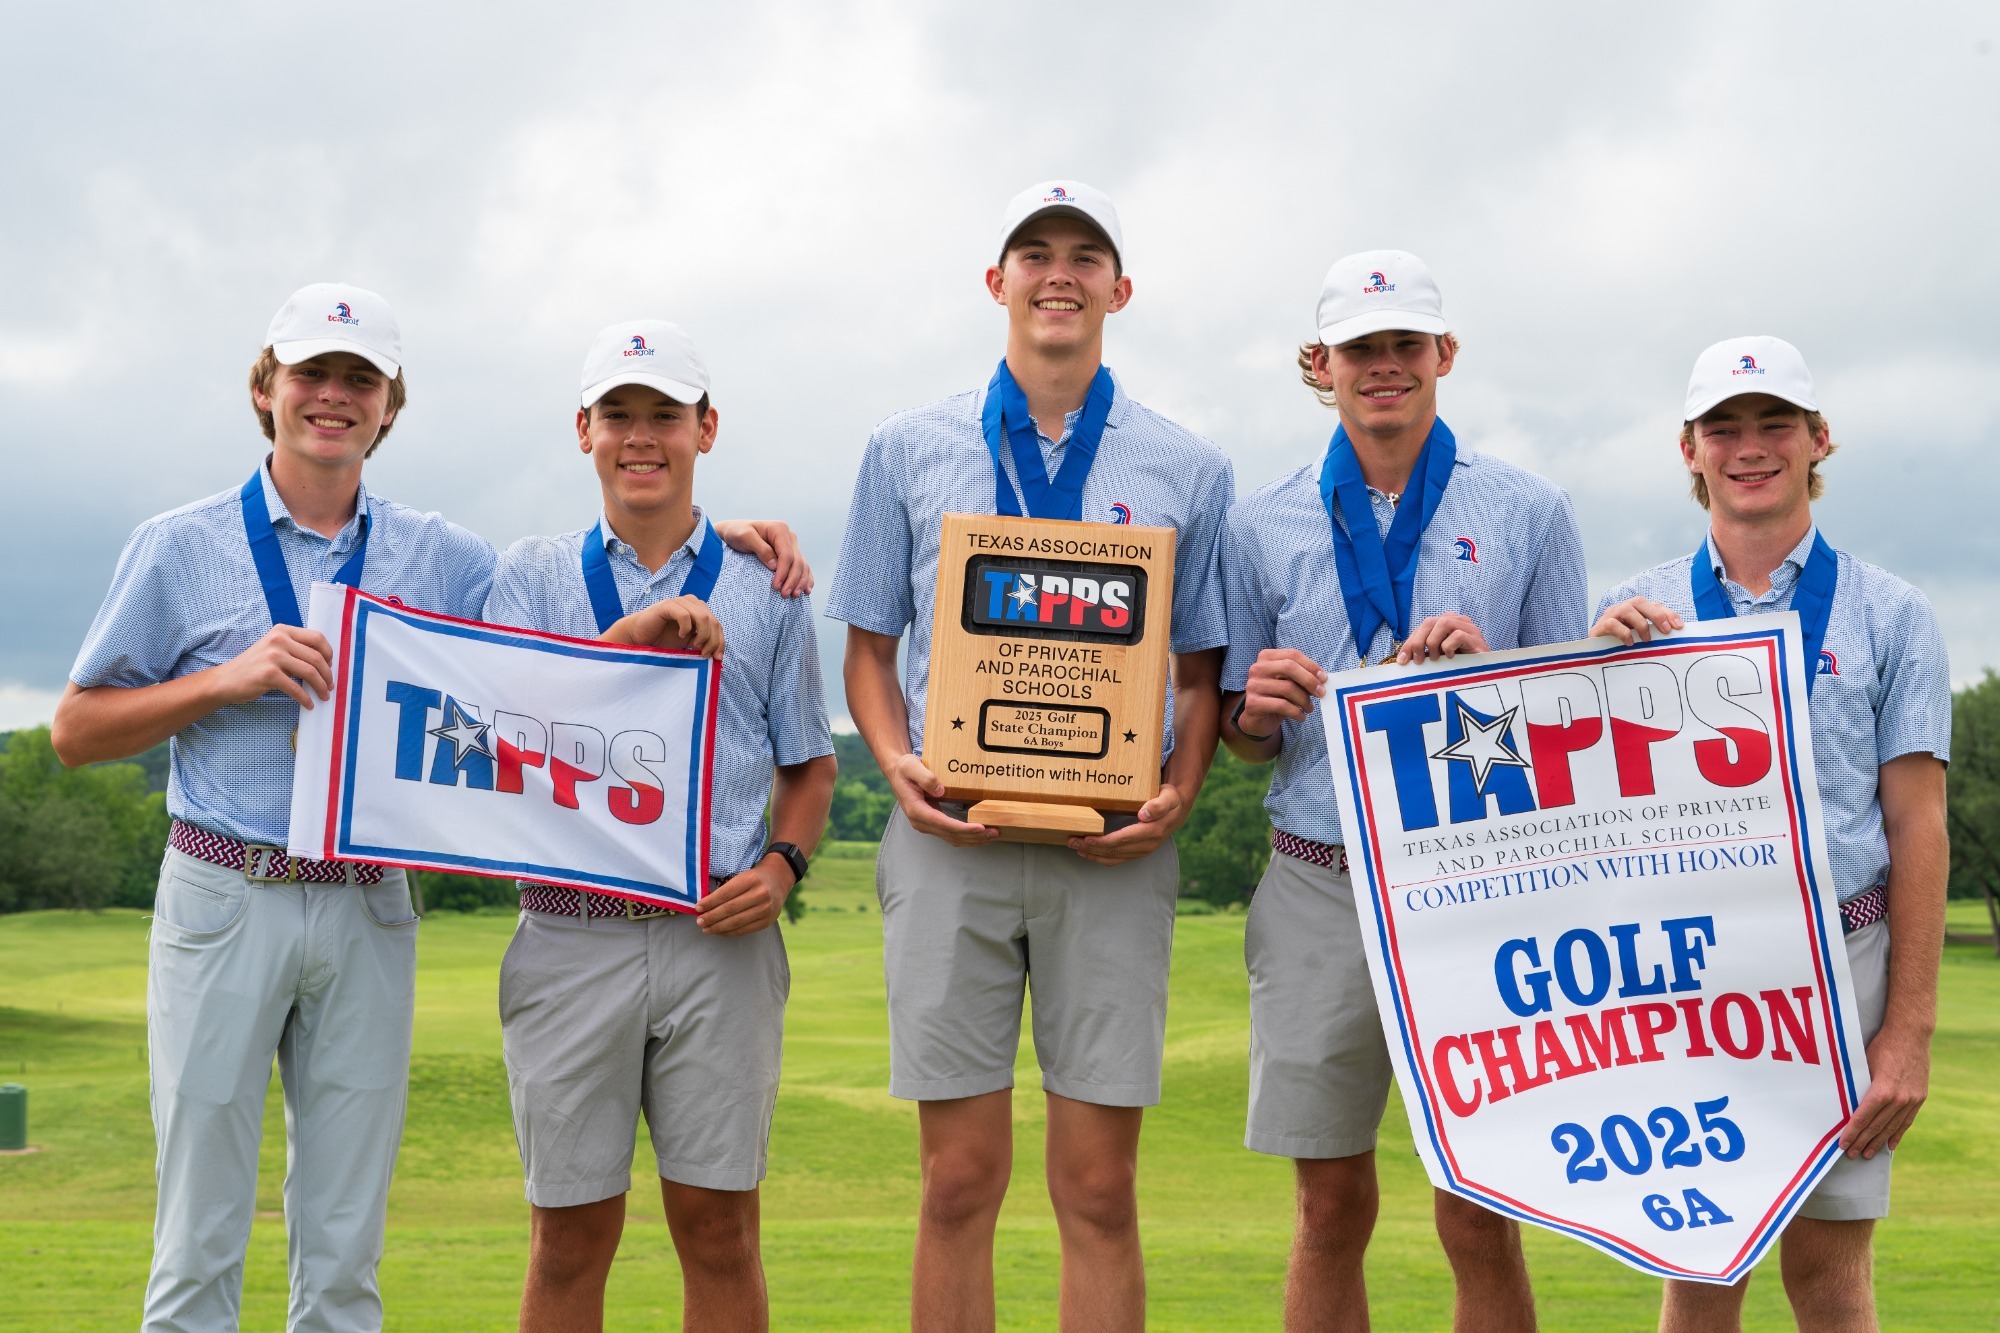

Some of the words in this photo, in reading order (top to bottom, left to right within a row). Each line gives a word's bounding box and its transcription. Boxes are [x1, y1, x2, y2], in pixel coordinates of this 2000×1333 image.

[1363, 284, 1396, 294] tcagolf
[327, 315, 360, 326] tcagolf
[623, 349, 656, 357] tcagolf
[967, 533, 1024, 550] TEXAS
[1028, 538, 1152, 560] ASSOCIATION
[984, 571, 1130, 628] TAPPS
[998, 643, 1024, 657] OF
[1028, 645, 1102, 664] PRIVATE
[975, 660, 1014, 675] AND
[1018, 662, 1122, 684] PAROCHIAL
[1002, 679, 1092, 700] SCHOOLS
[991, 720, 1024, 734] State
[1028, 723, 1098, 740] Champion
[1015, 710, 1042, 722] 2025
[1047, 712, 1077, 724] Golf
[385, 680, 666, 825] TAPPS
[1023, 737, 1039, 746] 6A
[1041, 737, 1064, 749] Boys
[1361, 654, 1772, 832] TAPPS
[947, 759, 1045, 779] Competition
[1049, 768, 1081, 782] with
[1086, 770, 1133, 785] Honor
[1403, 832, 1476, 857] TEXAS
[1484, 808, 1633, 844] ASSOCIATION
[1642, 805, 1669, 820] OF
[1678, 795, 1771, 817] PRIVATE
[1435, 854, 1485, 875] AND
[1495, 833, 1632, 865] PAROCHIAL
[1642, 821, 1748, 844] SCHOOLS
[1406, 861, 1590, 912] COMPETITION
[1596, 853, 1670, 880] WITH
[1677, 843, 1778, 873] HONOR
[1494, 915, 1716, 1018] GOLF
[1432, 985, 1821, 1118] CHAMPION
[1550, 1095, 1745, 1184] 2025
[1641, 1187, 1734, 1231] 6A
